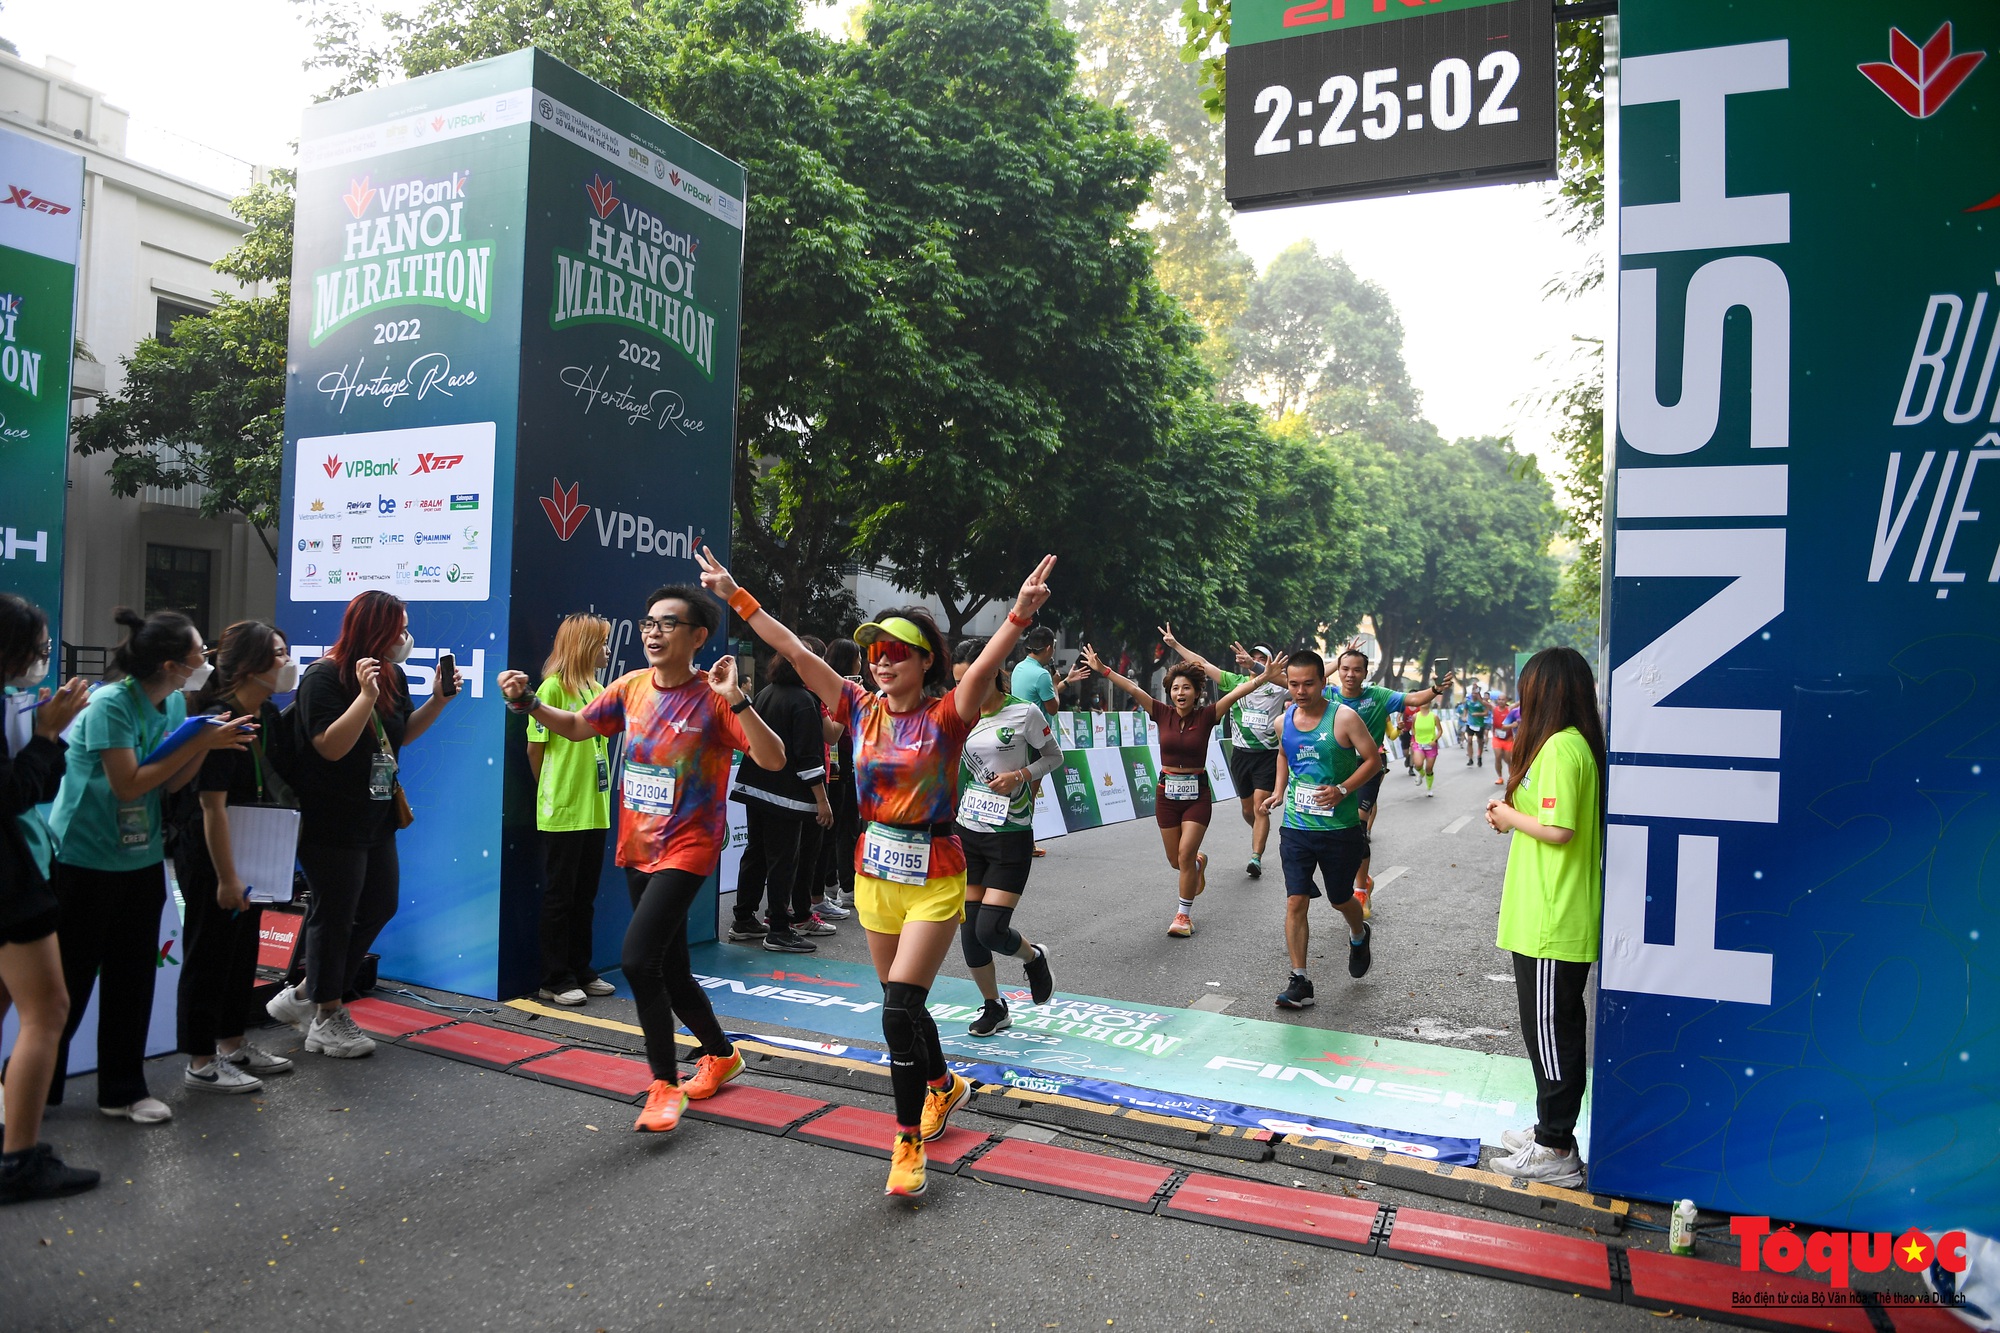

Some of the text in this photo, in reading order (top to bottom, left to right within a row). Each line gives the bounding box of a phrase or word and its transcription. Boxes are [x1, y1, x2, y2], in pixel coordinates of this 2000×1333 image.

[1254, 50, 1520, 157] 2:25:02
[447, 111, 486, 130] VPBank
[379, 172, 467, 213] VPBank
[682, 179, 713, 206] VPBank
[343, 201, 464, 262] HANOI
[622, 202, 698, 261] VPBank
[587, 217, 695, 300] HANOI
[313, 246, 491, 340] MARATHON
[555, 254, 715, 375] MARATHON
[373, 318, 421, 345] 2022
[618, 339, 661, 371] 2022
[316, 352, 477, 414] Heritage Race
[559, 364, 705, 437] Heritage Race
[345, 458, 399, 479] VPBank
[408, 452, 464, 476] XTEP
[378, 493, 396, 514] be
[1867, 432, 2000, 599] VIỆ
[595, 507, 702, 560] VPBank
[1601, 38, 1790, 1005] FINISH
[388, 534, 404, 543] IRC
[422, 566, 441, 577] ACC
[636, 783, 668, 800] 21304
[976, 799, 1006, 814] 24202
[123, 833, 147, 844] CREW
[884, 849, 923, 869] 29155
[1007, 999, 1157, 1031] HANOI
[1049, 998, 1169, 1022] VPBank
[1203, 1055, 1517, 1117] FINISH
